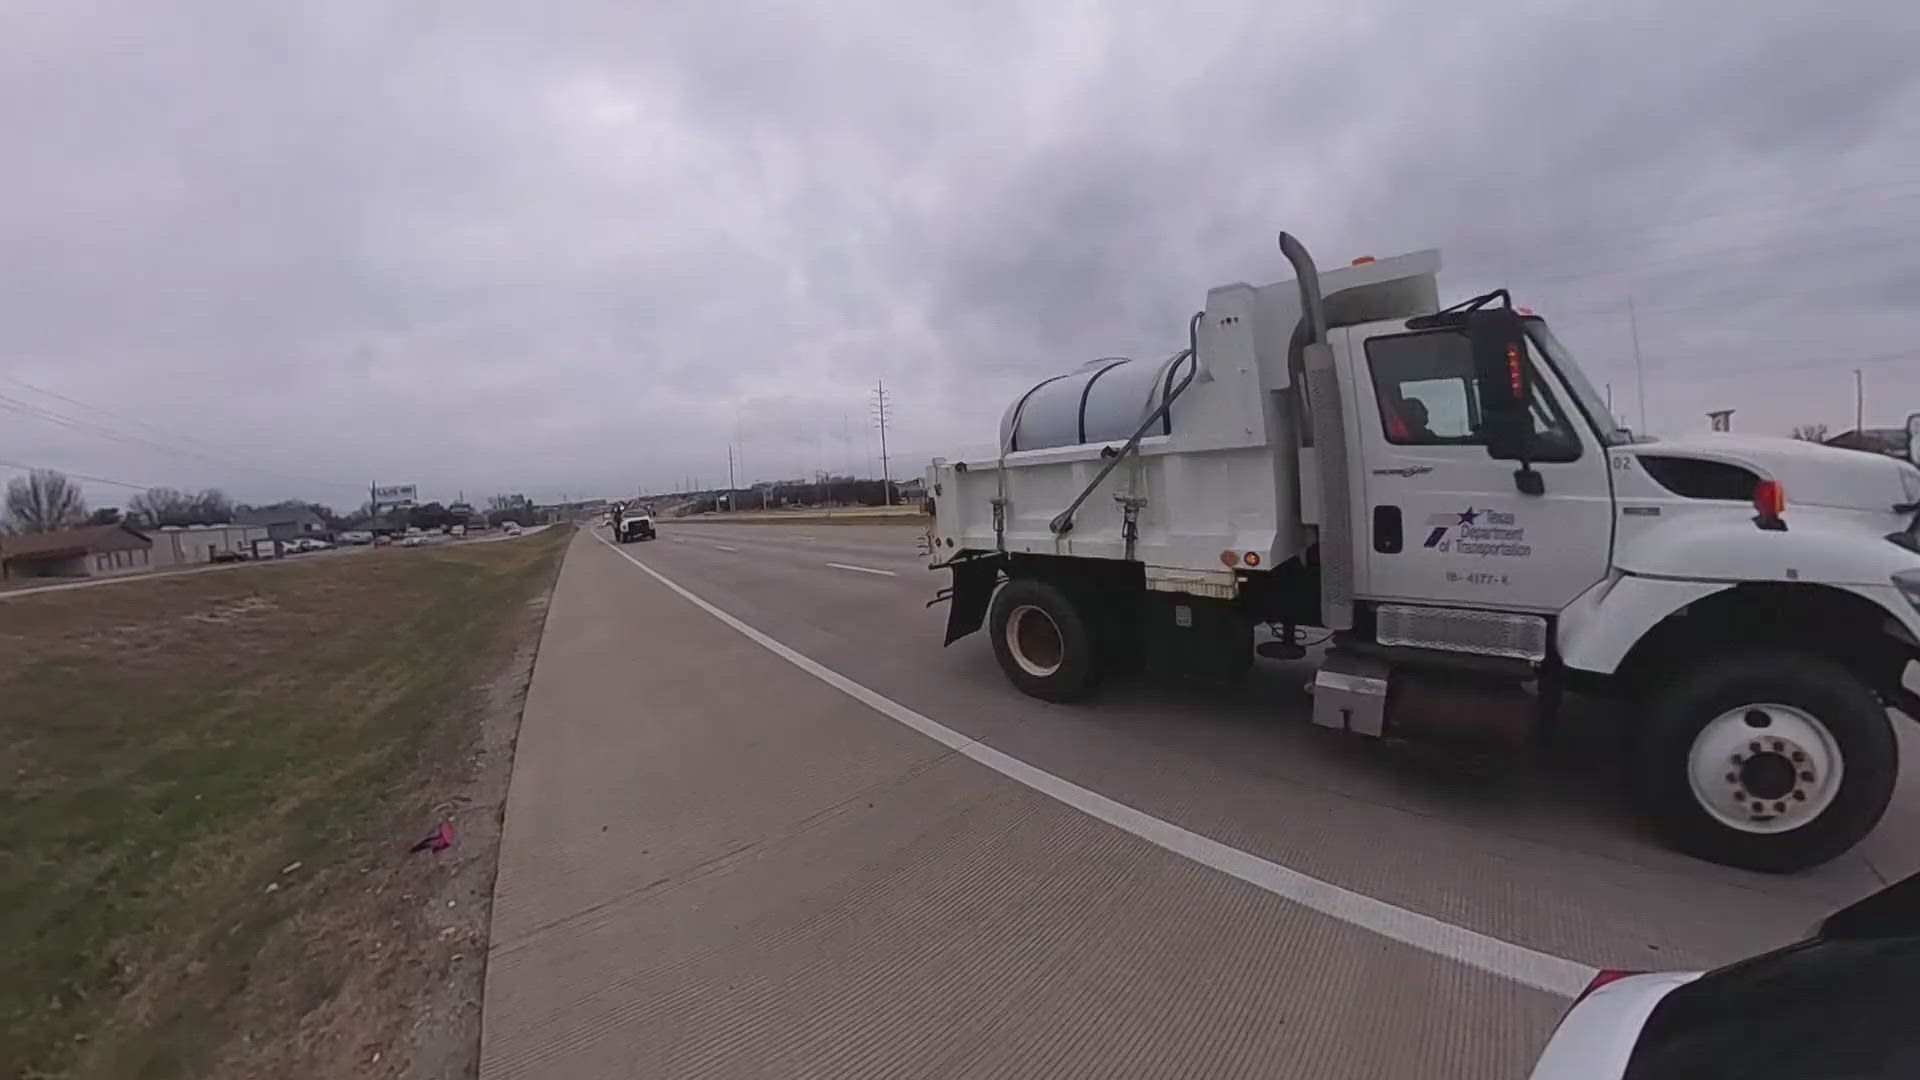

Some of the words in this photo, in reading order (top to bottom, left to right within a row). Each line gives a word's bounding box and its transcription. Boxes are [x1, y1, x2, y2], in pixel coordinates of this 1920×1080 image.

[1482, 509, 1514, 525] Texas
[1461, 524, 1524, 541] Department
[1439, 540, 1450, 552] of
[1456, 539, 1532, 557] Transportation
